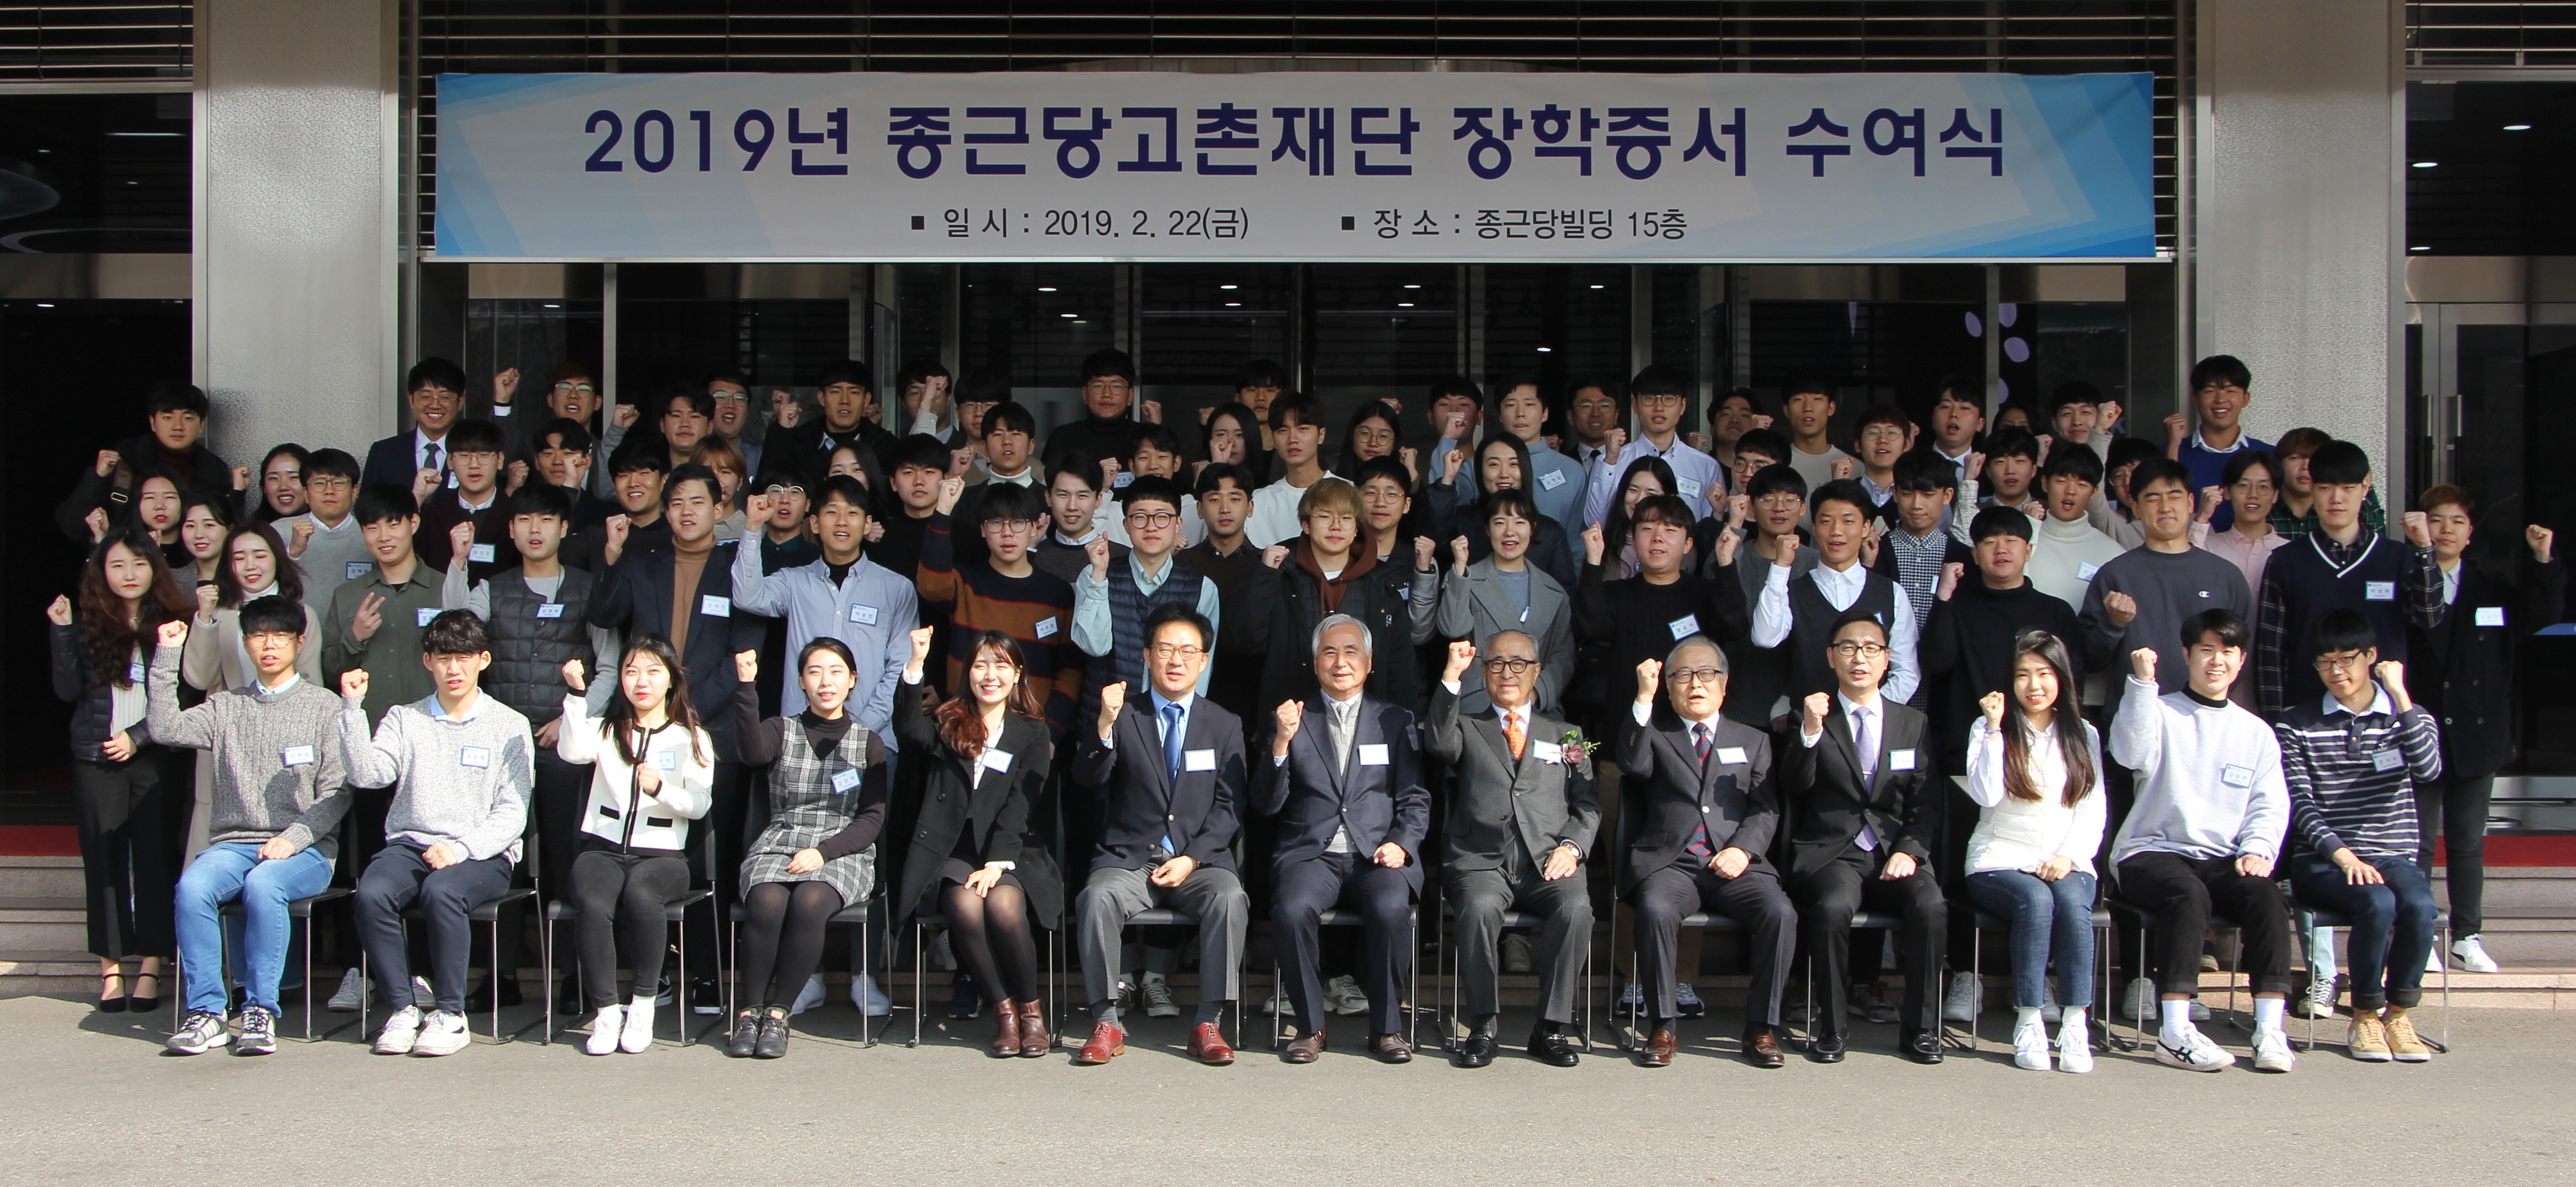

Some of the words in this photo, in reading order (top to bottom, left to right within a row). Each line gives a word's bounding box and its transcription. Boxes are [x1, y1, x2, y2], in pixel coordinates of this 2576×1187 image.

[585, 107, 848, 176] 2019년
[887, 102, 1420, 179] 종근당고촌재단
[1453, 103, 1746, 180] 장학증서
[1786, 108, 2003, 177] 수여식
[1045, 210, 1119, 237] 2019.
[1169, 207, 1248, 240] 22(금)
[1475, 209, 1612, 240] 종근당빌딩
[1628, 209, 1687, 240] 15층
